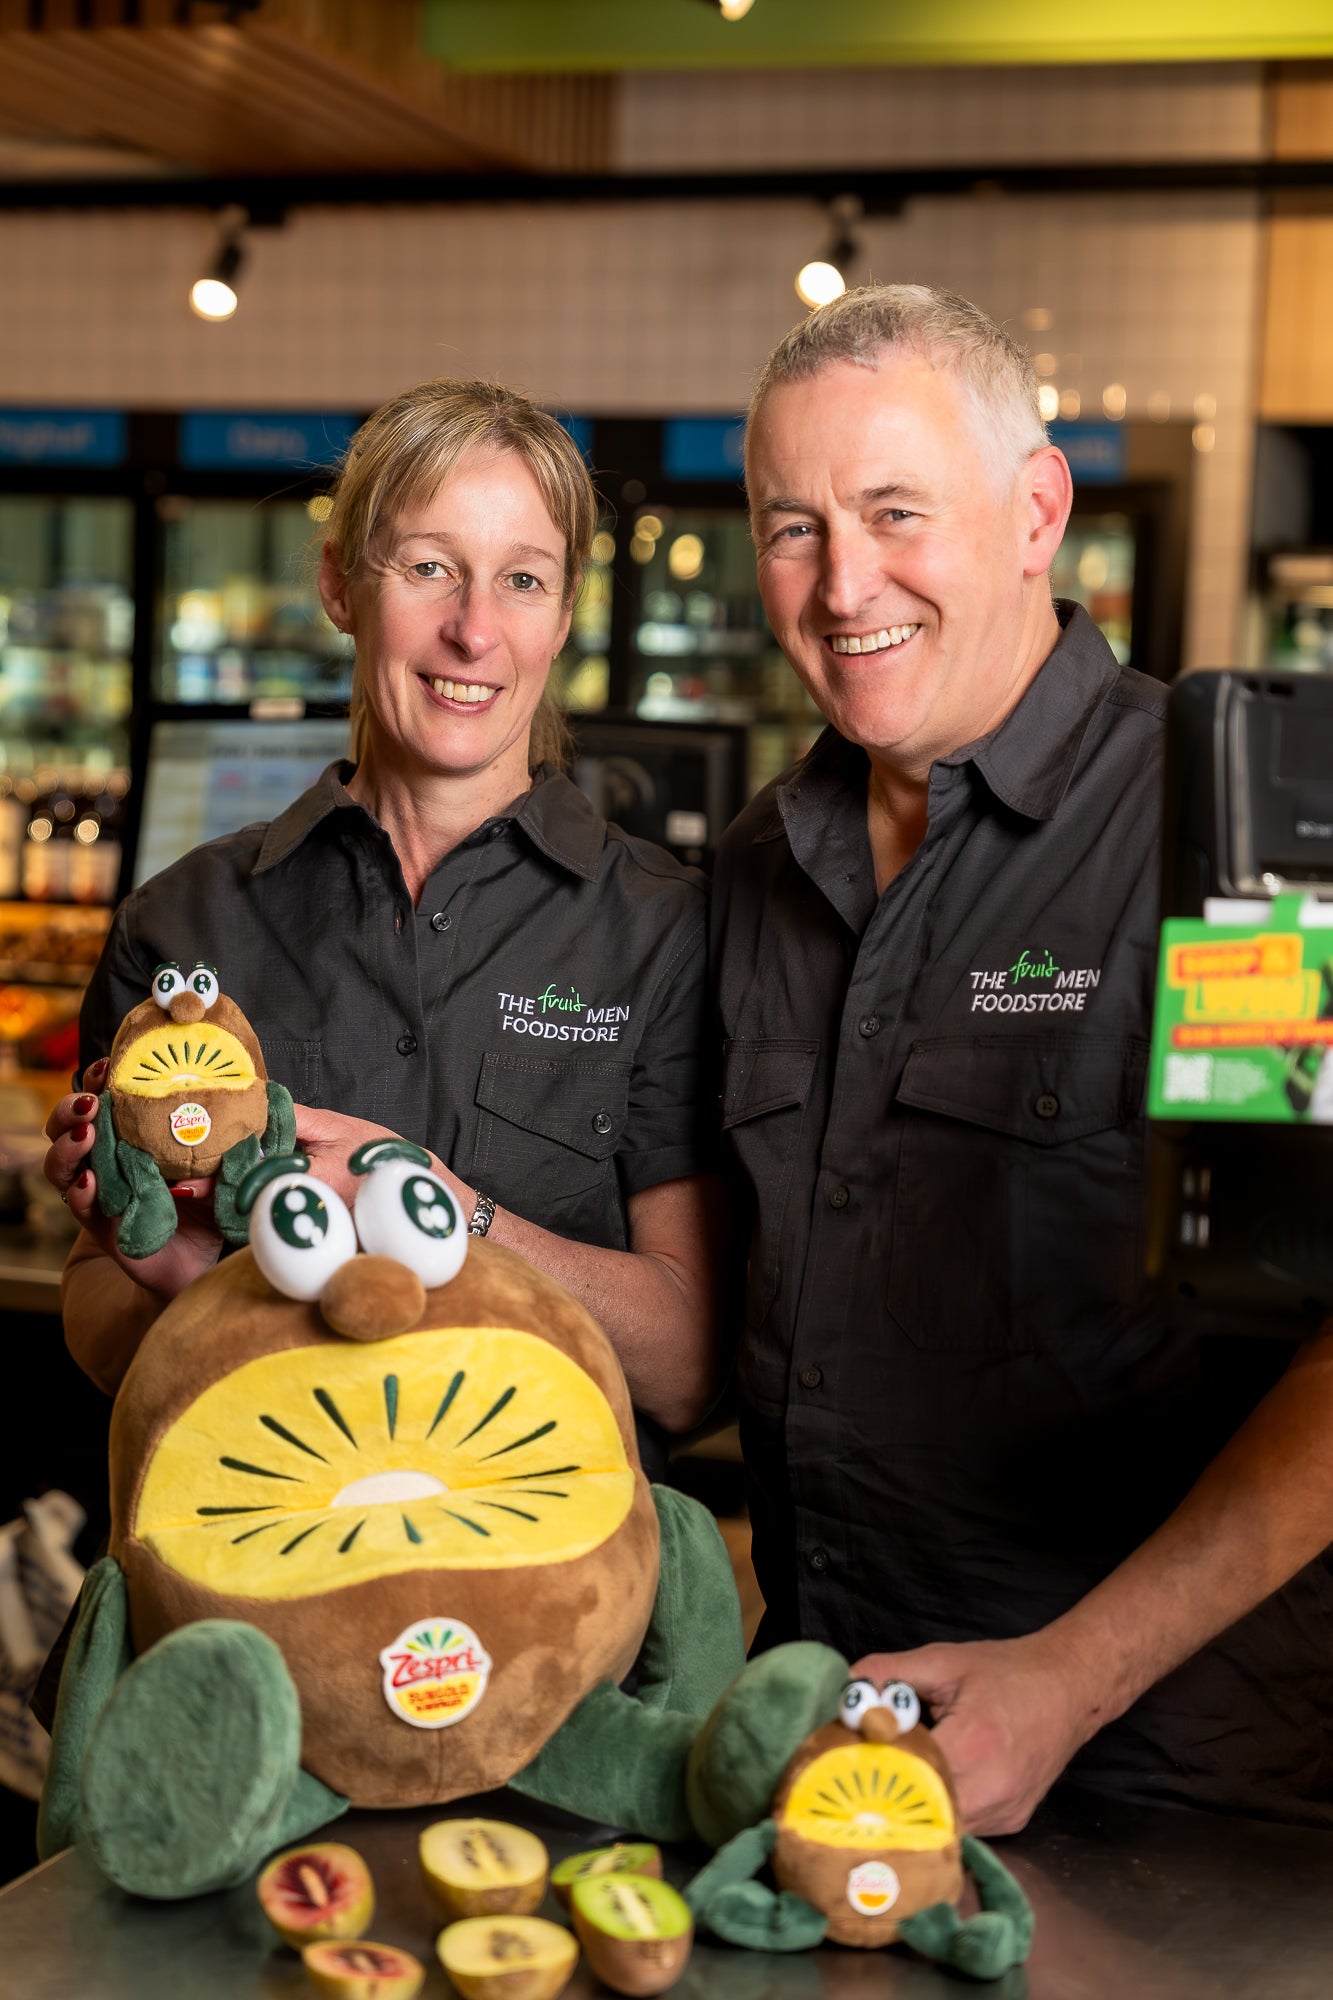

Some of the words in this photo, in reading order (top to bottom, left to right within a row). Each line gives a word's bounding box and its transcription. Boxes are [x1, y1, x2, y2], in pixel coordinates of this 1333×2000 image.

[970, 971, 1007, 989] THE
[1009, 949, 1060, 984] fruit
[1054, 969, 1101, 989] MEN
[498, 992, 535, 1015] THE
[537, 983, 588, 1013] fruit
[586, 1005, 630, 1024] MEN
[971, 993, 1087, 1012] FOODSTORE
[502, 1015, 620, 1042] FOODSTORE
[173, 1114, 206, 1128] Zespri
[390, 1647, 482, 1687] Zespri
